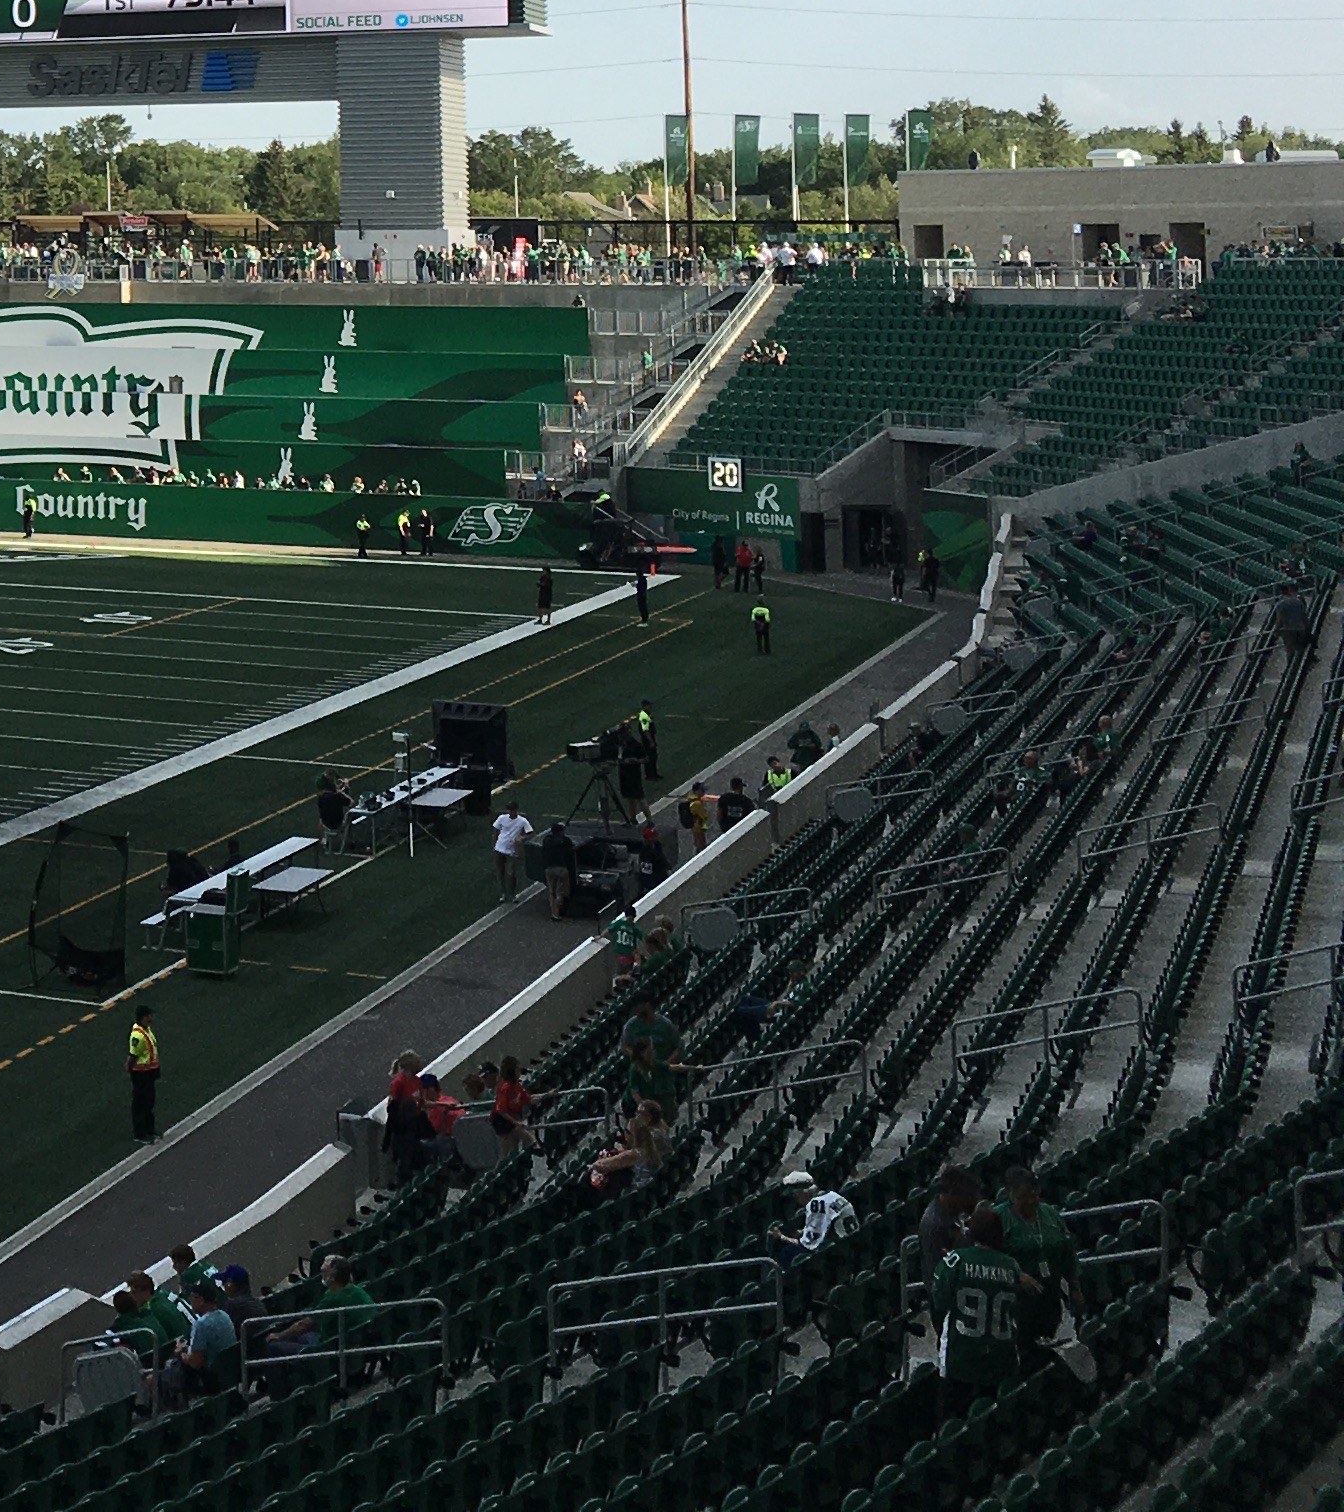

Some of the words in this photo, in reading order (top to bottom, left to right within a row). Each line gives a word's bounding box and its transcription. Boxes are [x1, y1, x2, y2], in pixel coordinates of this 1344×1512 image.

[296, 14, 344, 28] SOCIAL
[347, 14, 382, 26] FEED
[28, 50, 192, 97] SaskTel
[712, 462, 739, 487] 20
[672, 508, 689, 521] City
[691, 509, 701, 519] of
[745, 511, 794, 528] REGINA
[810, 1199, 826, 1214] 81
[964, 1262, 1016, 1285] HAWKINS
[955, 1287, 1017, 1340] 90
